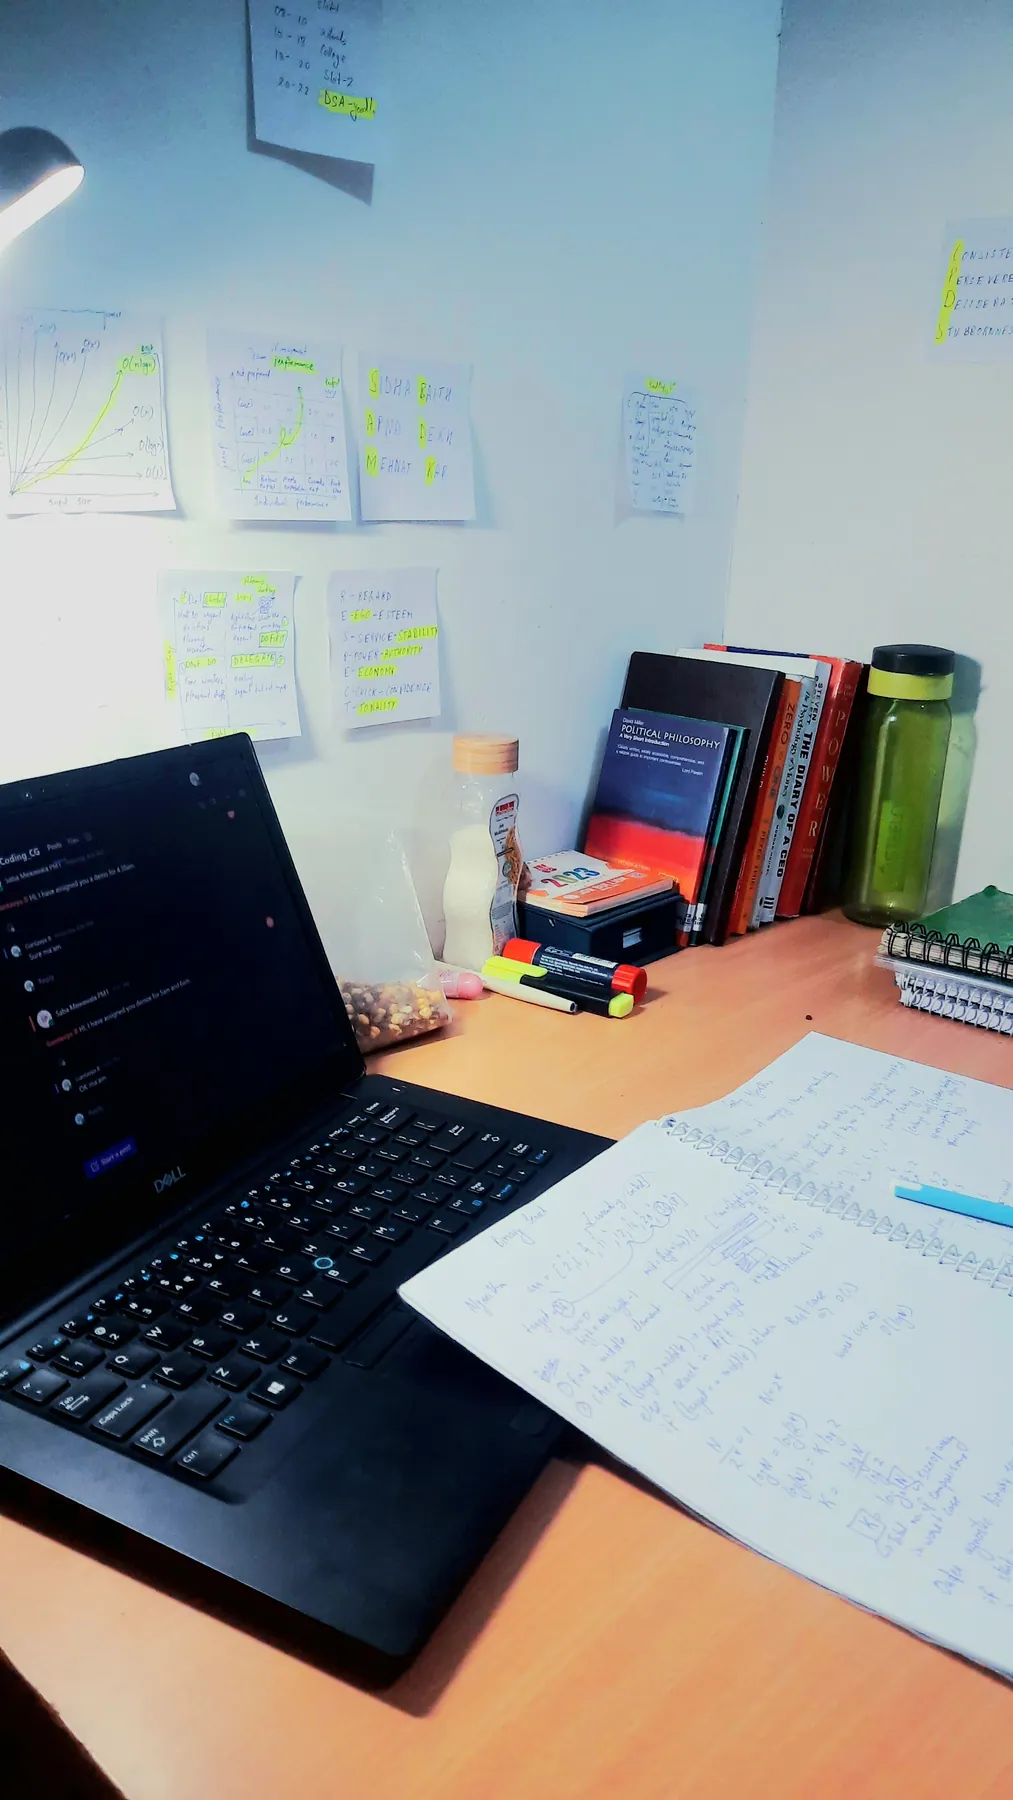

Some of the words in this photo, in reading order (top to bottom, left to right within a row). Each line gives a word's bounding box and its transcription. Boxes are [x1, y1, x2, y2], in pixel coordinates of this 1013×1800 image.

[780, 702, 796, 745] ZERO
[620, 724, 662, 739] POLITICAL
[663, 731, 721, 750] PHILOSOPHY
[799, 731, 814, 760] THE
[790, 763, 807, 810] DIARY
[786, 813, 796, 832] OF
[782, 835, 791, 846] A
[0, 847, 41, 866] Coding_CG
[776, 849, 788, 878] CEO
[540, 867, 601, 888] 2023
[152, 1165, 188, 1194] DELL
[304, 1244, 318, 1253] H
[352, 1246, 366, 1255] N
[237, 1257, 249, 1266] T
[279, 1266, 291, 1274] G
[327, 1269, 340, 1277] B
[209, 1279, 223, 1289] R
[251, 1288, 262, 1297] F
[302, 1289, 314, 1299] V
[179, 1303, 193, 1313] E
[222, 1312, 235, 1321] D
[275, 1314, 289, 1324] C
[146, 1326, 163, 1338] W
[192, 1338, 205, 1348] S
[246, 1340, 260, 1350] X
[114, 1354, 129, 1364] Q
[161, 1365, 174, 1376] A
[215, 1367, 230, 1378] Z
[98, 1408, 119, 1426] Caps
[114, 1396, 134, 1414] Lock
[139, 1427, 159, 1444] Shift
[182, 1450, 199, 1464] Ctrl
